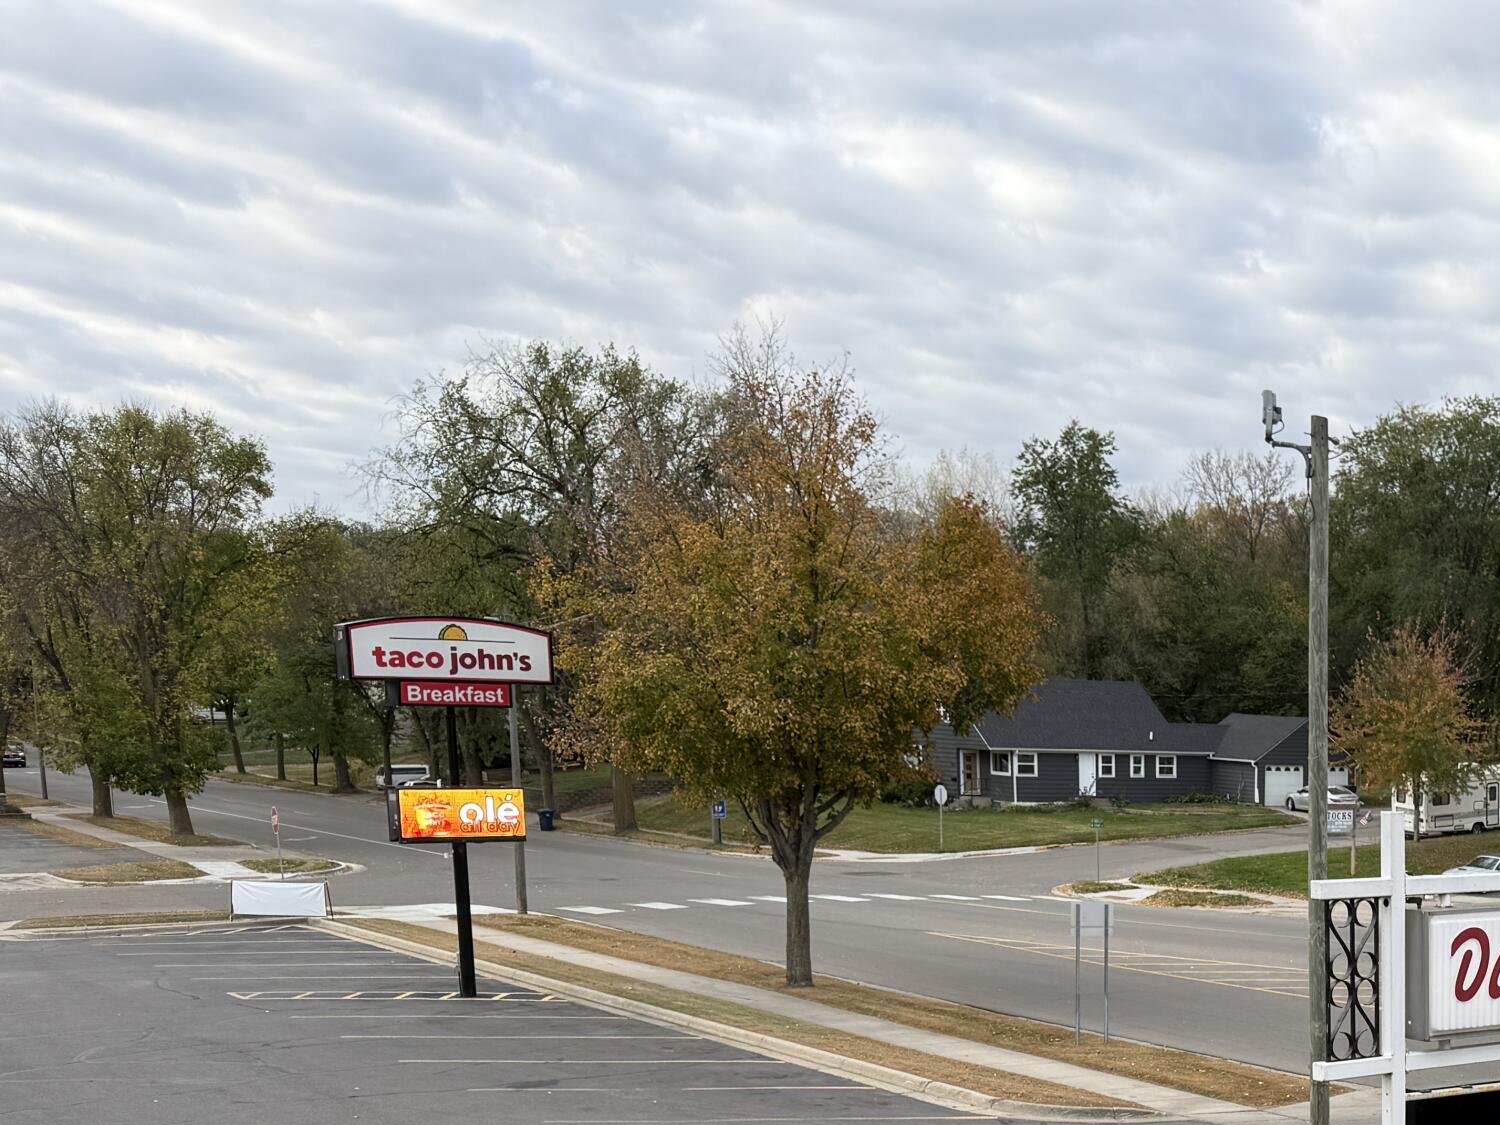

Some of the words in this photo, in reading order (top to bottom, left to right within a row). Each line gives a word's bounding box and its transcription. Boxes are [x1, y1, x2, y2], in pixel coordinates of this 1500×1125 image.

[372, 646, 444, 669] taco
[449, 646, 532, 675] john's
[406, 685, 504, 703] Breakfast
[459, 794, 520, 825] olé
[1327, 811, 1352, 820] TOCKS
[461, 820, 481, 833] all
[487, 819, 520, 836] day
